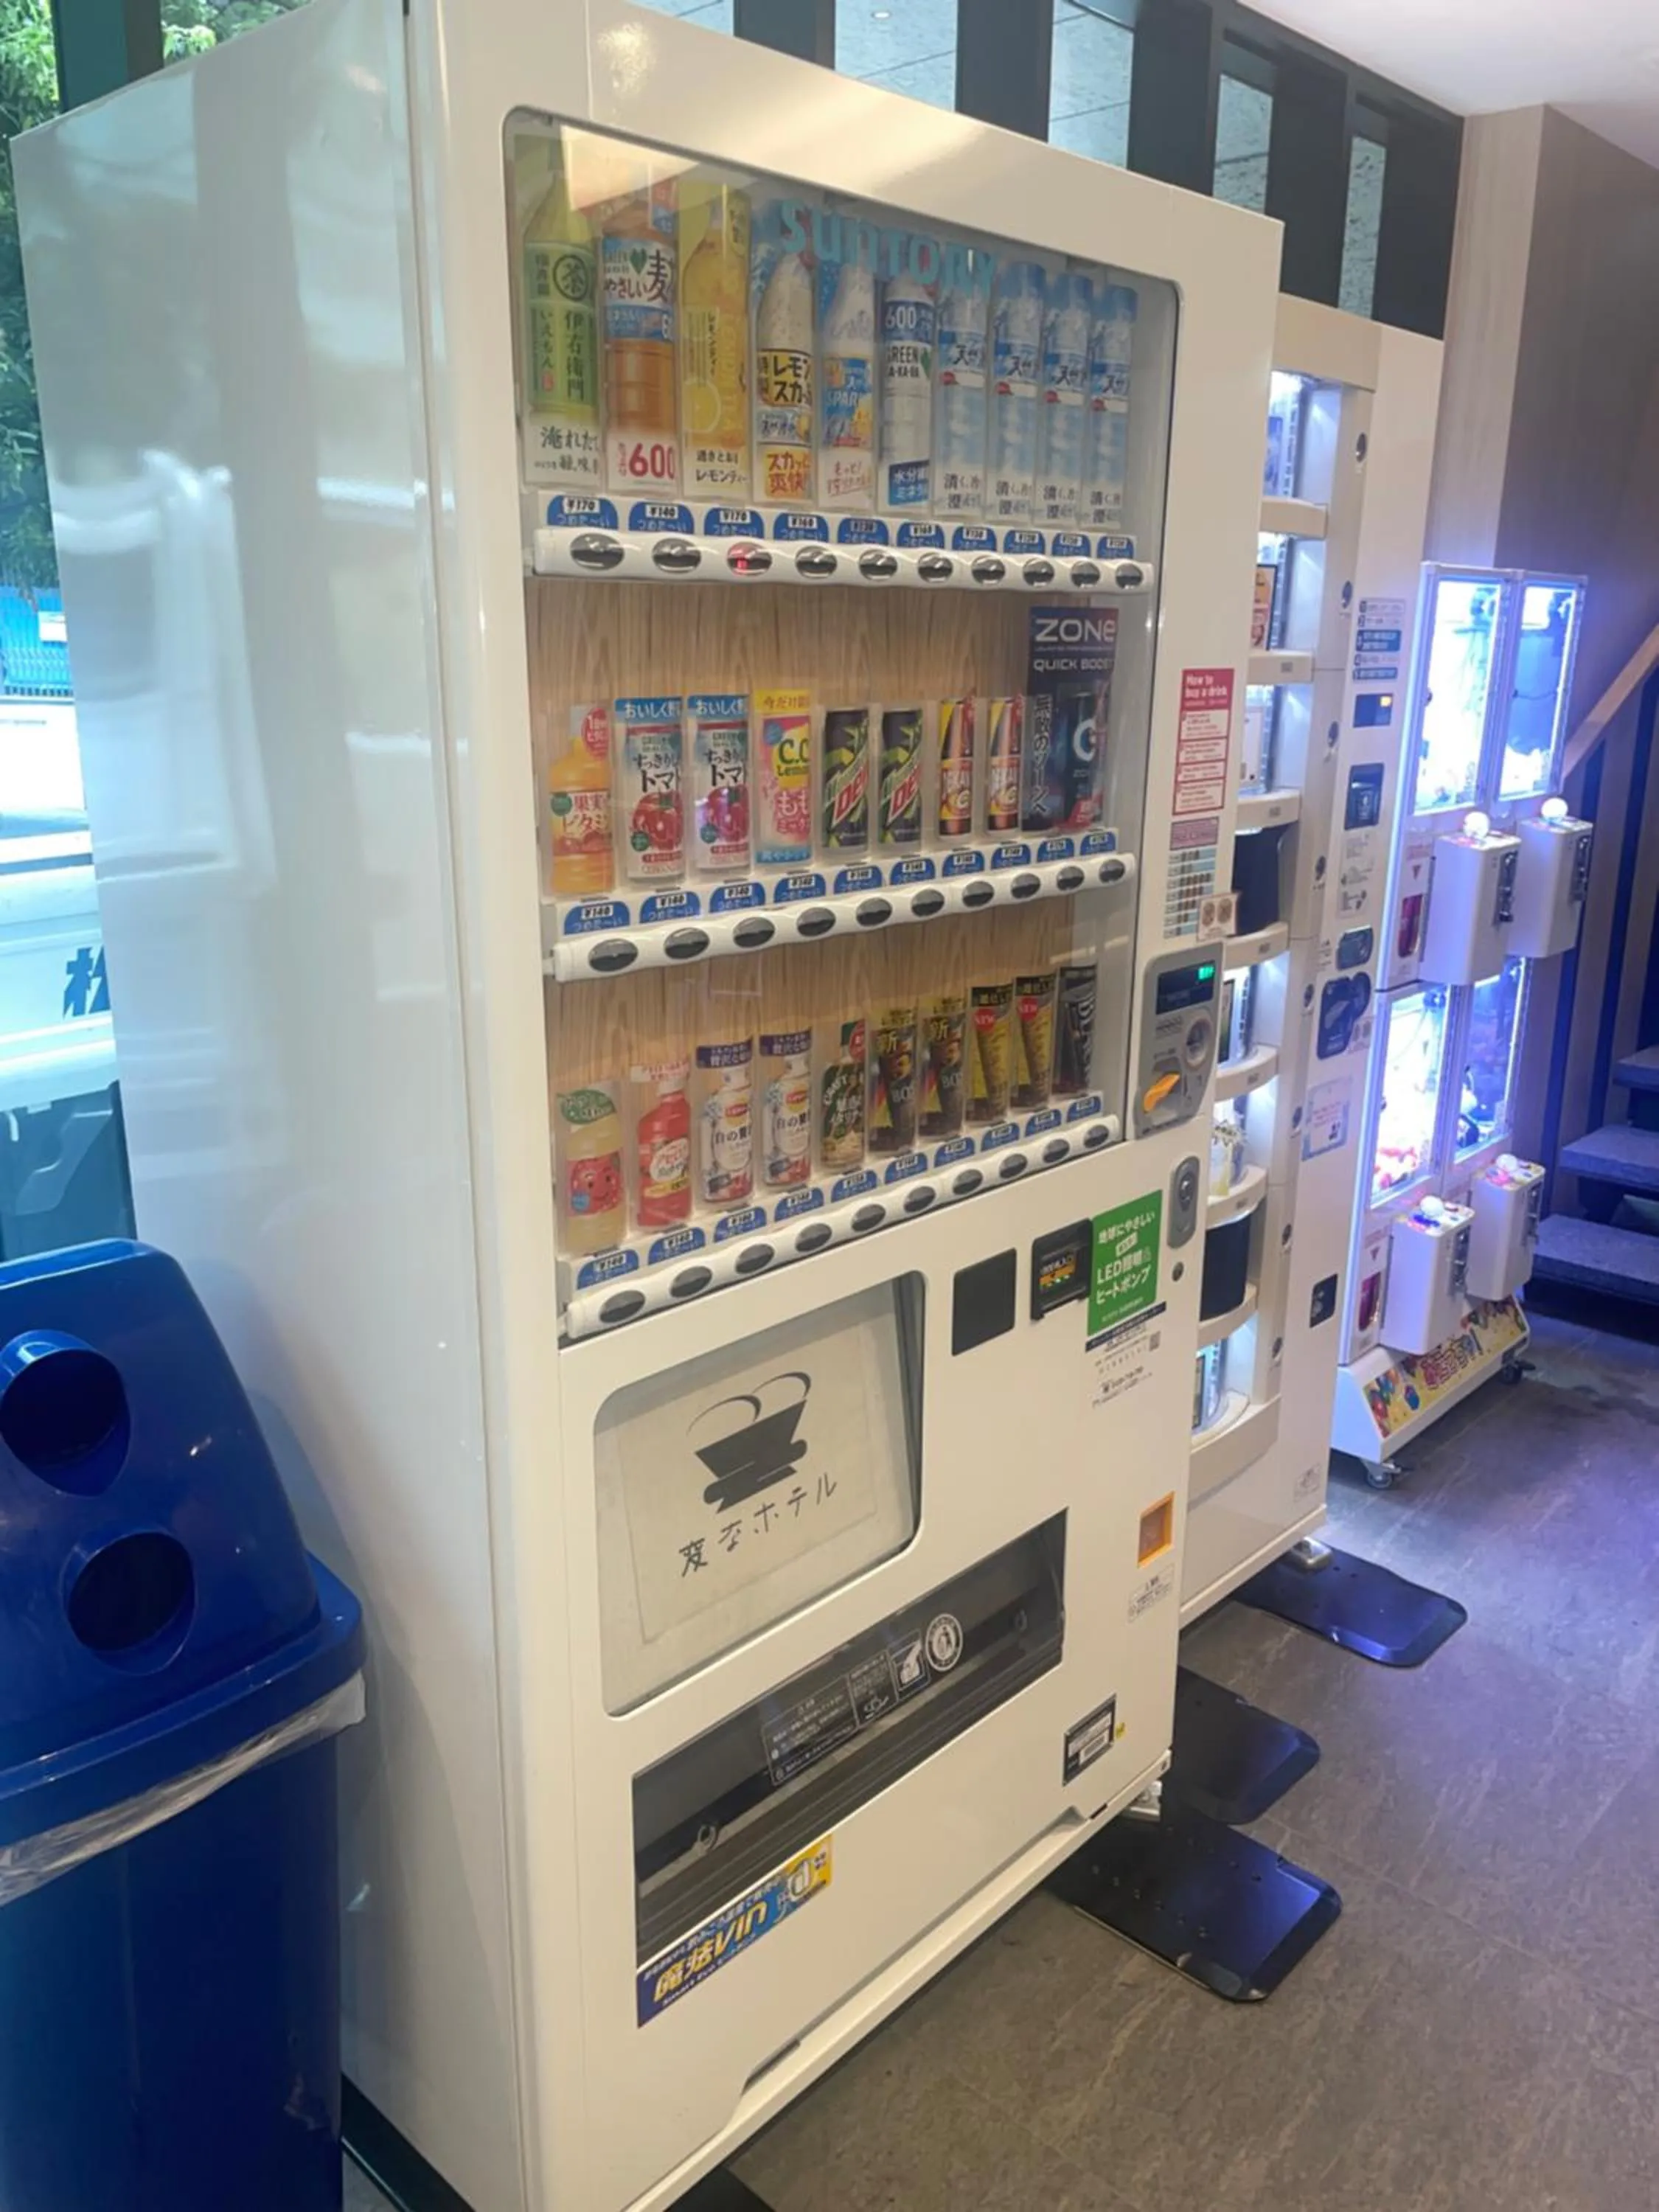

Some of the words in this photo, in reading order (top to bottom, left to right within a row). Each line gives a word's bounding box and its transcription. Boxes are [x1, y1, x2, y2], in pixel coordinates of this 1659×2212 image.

[679, 1472, 838, 1577] 変なホテル
